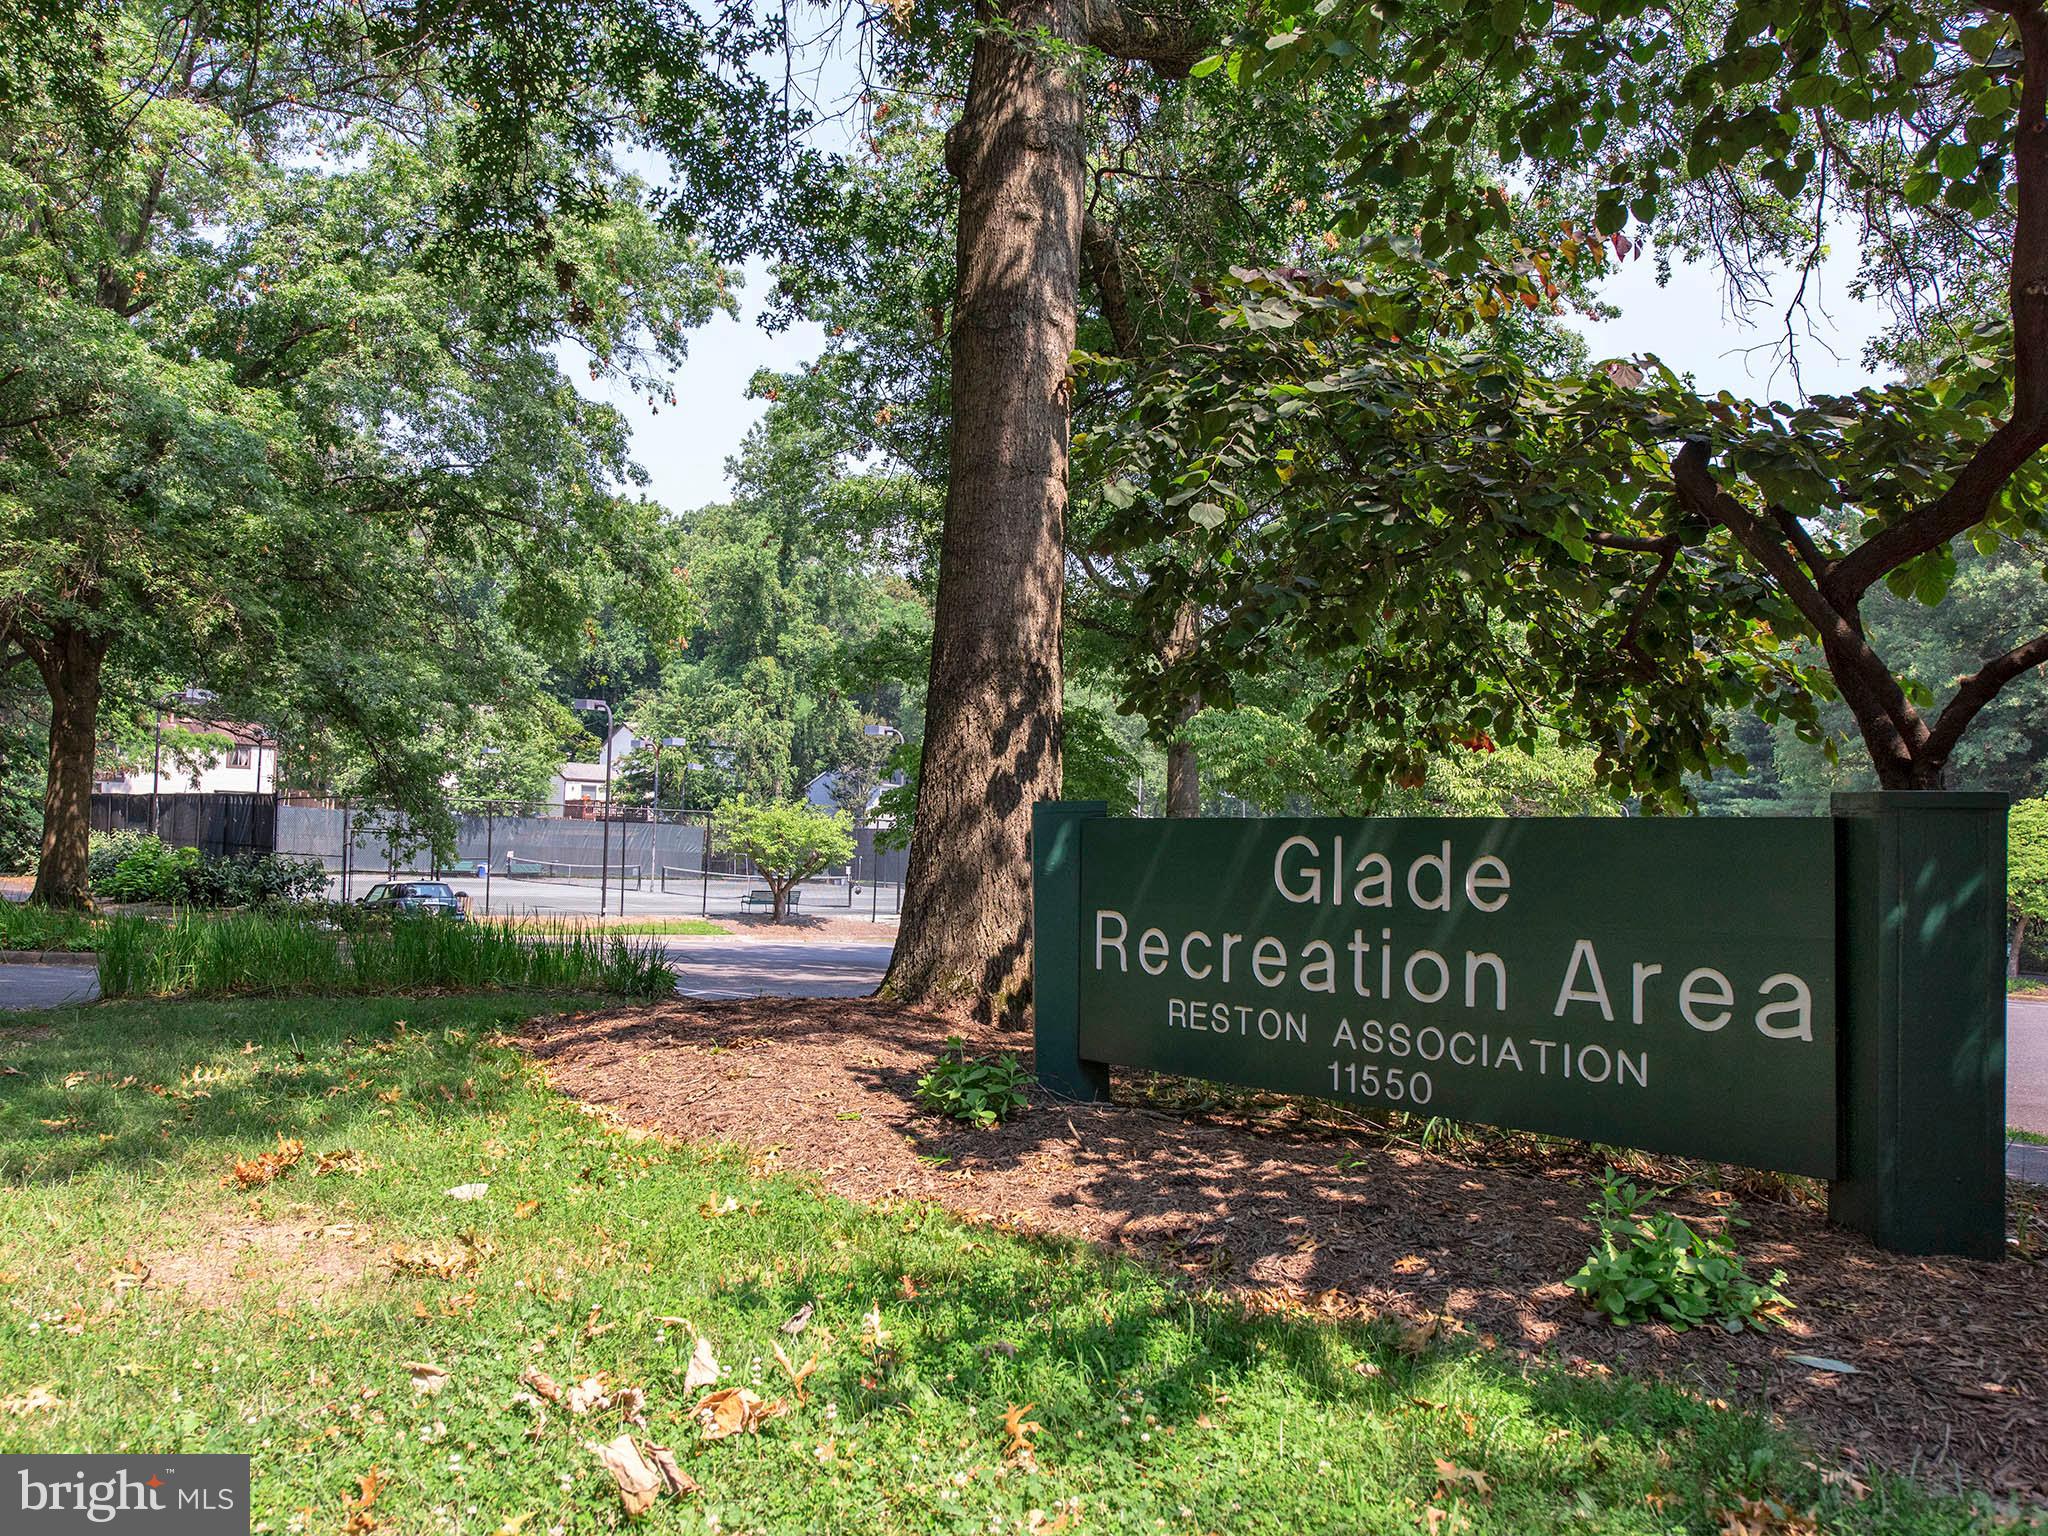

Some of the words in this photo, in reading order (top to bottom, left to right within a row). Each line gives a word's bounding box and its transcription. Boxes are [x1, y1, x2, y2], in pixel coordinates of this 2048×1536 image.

[1274, 835, 1512, 914] Glade
[1095, 909, 1508, 1011] Recreation
[1553, 939, 1814, 1043] Area
[1167, 998, 1307, 1043] RESTON
[1332, 1018, 1649, 1088] ASSOCIATION
[1327, 1062, 1433, 1105] 11550
